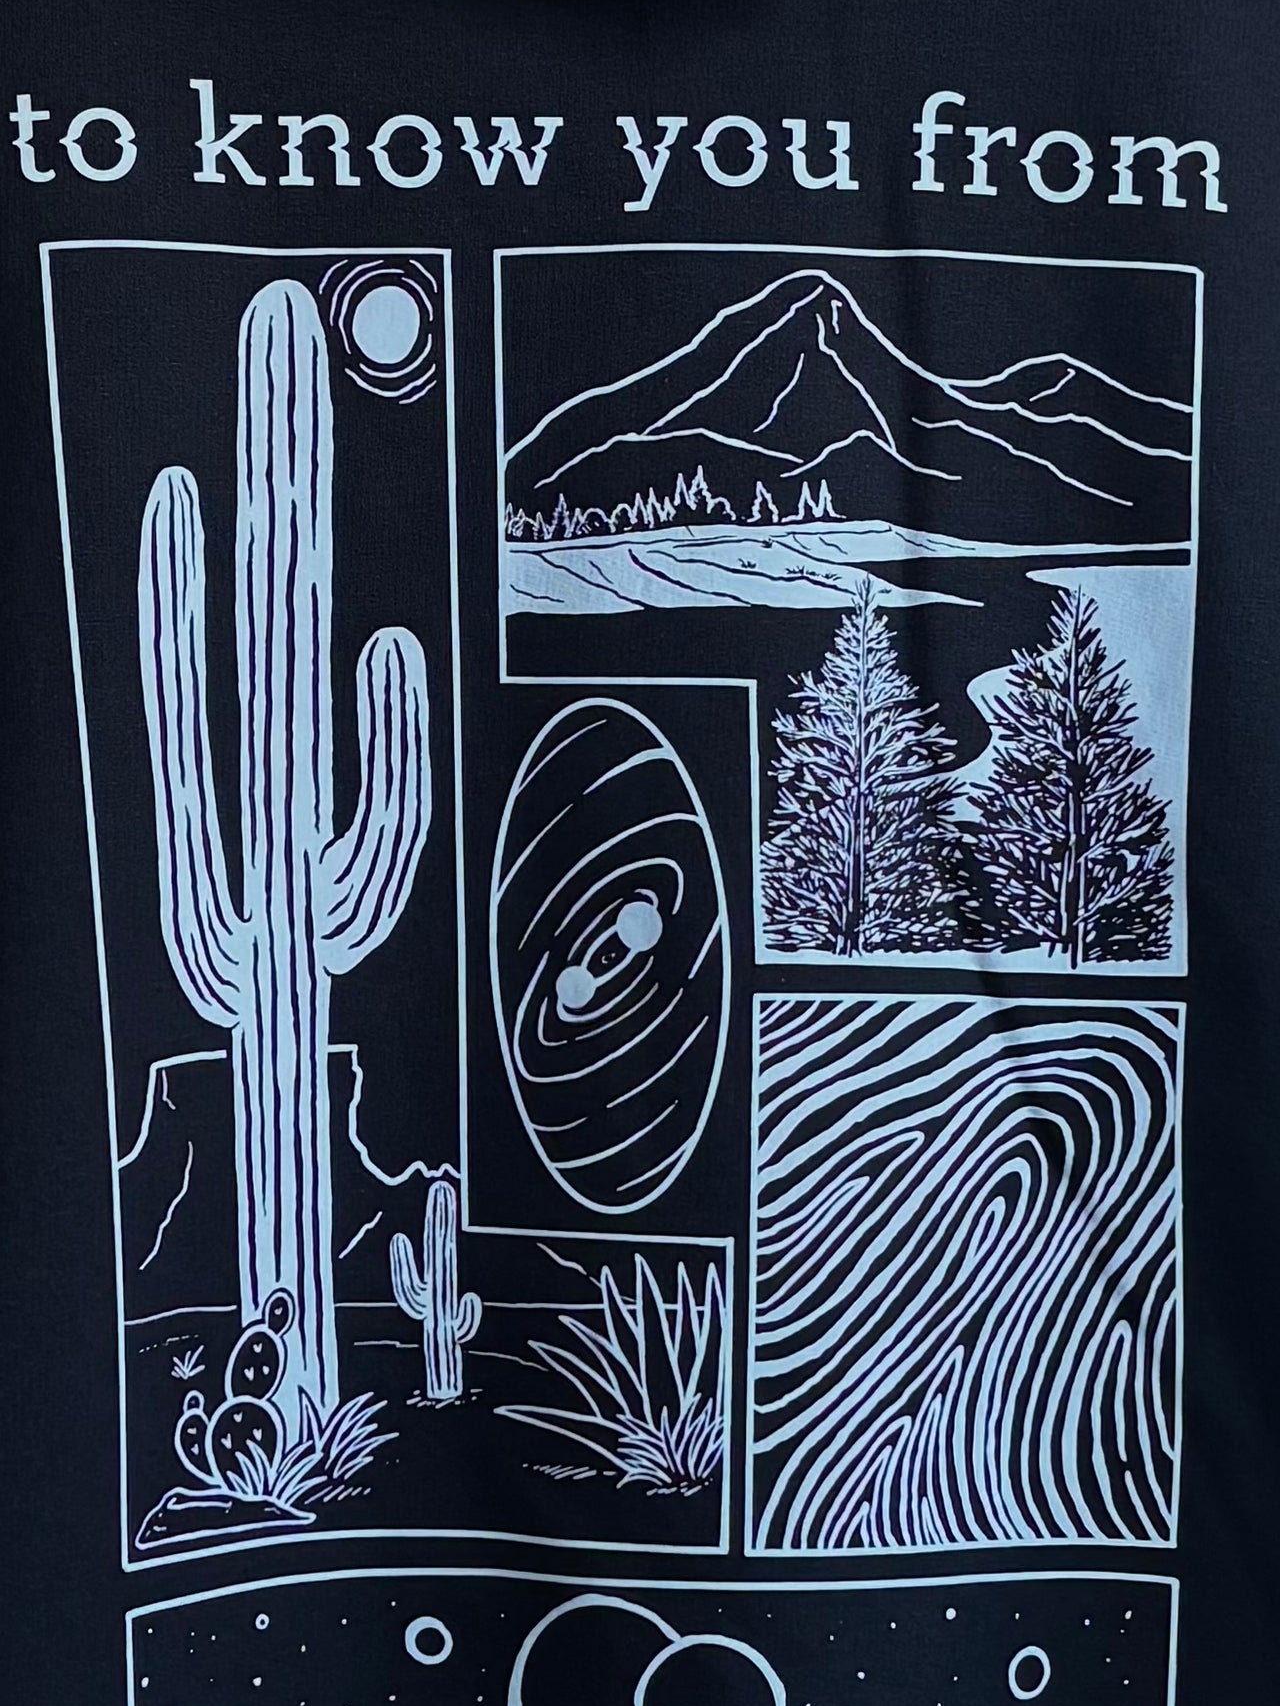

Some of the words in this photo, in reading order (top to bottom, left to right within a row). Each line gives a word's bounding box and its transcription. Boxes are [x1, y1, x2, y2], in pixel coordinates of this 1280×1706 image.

[9, 93, 138, 183] to
[189, 78, 564, 189] know
[615, 113, 860, 212] you
[911, 89, 1228, 213] from
